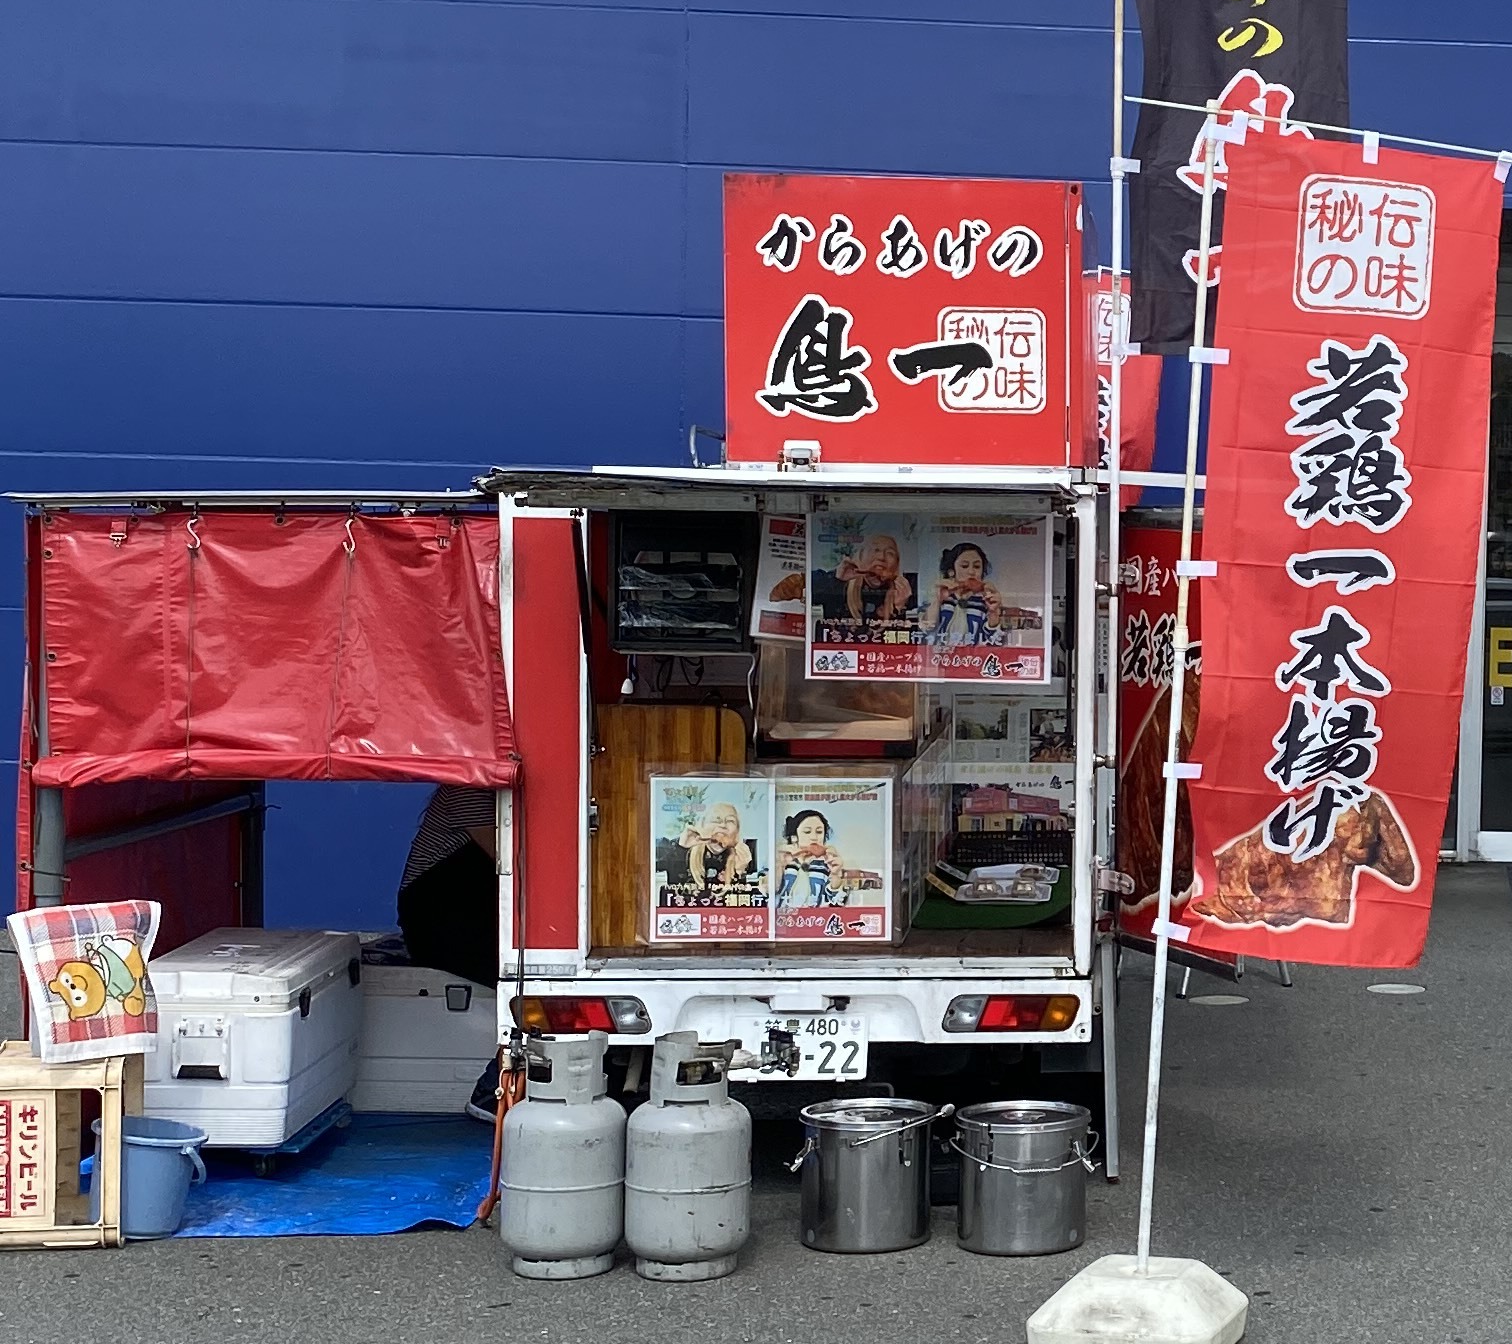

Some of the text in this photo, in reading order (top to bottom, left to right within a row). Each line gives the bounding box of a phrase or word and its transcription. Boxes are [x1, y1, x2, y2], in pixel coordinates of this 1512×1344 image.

[756, 213, 1042, 279] からあげの
[1308, 188, 1422, 248] 秘伝
[1307, 253, 1419, 308] の味
[1265, 336, 1410, 860] 若鶏一本揚げ
[805, 1018, 839, 1036] 480
[19, 1105, 38, 1211] キリンビール
